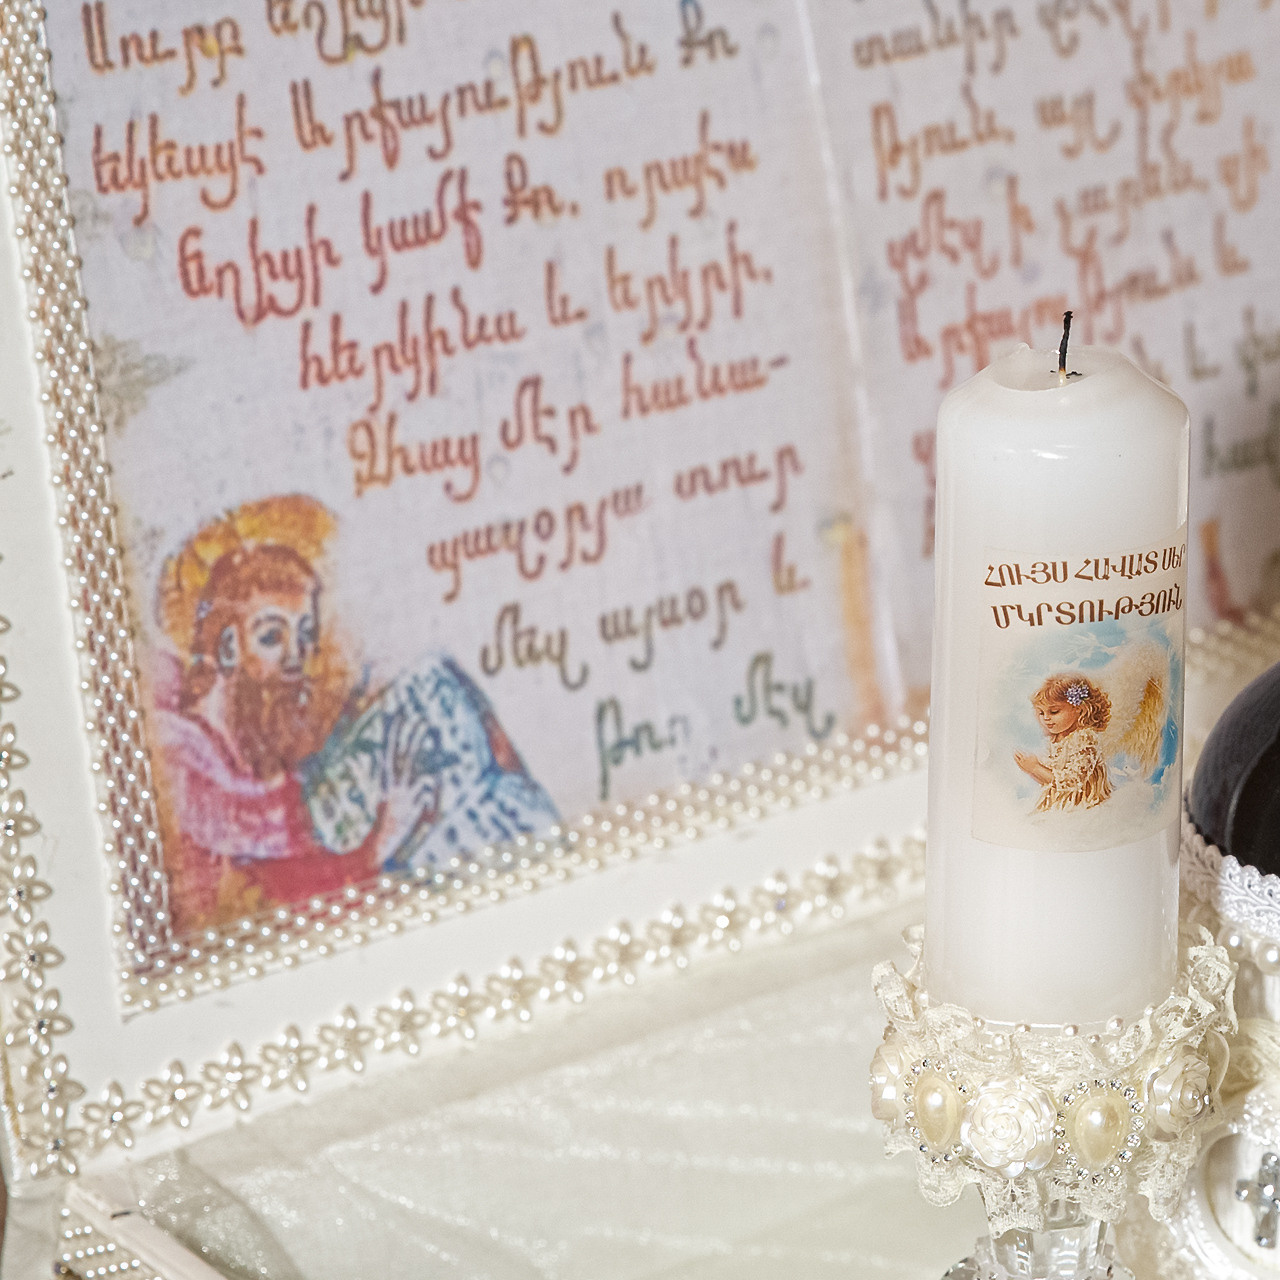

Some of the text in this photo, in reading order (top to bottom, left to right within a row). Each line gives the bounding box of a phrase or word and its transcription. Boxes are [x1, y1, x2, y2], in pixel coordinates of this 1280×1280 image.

[289, 10, 656, 182] Արքայություն
[178, 201, 342, 327] Եղիցի
[360, 166, 483, 295] կամք
[602, 108, 758, 231] որպէս
[544, 259, 588, 326] և
[499, 374, 600, 474] մէր
[673, 442, 805, 514] տուր
[599, 577, 745, 673] այսօր
[770, 530, 811, 596] և
[983, 560, 1069, 588] ՀՈՒՅՍ
[1074, 549, 1159, 582] ՀԱՎԱՏ
[990, 583, 1183, 629] ՄԿՐՏՈՒԹՅՈՒՆ
[733, 650, 837, 741] մէզ
